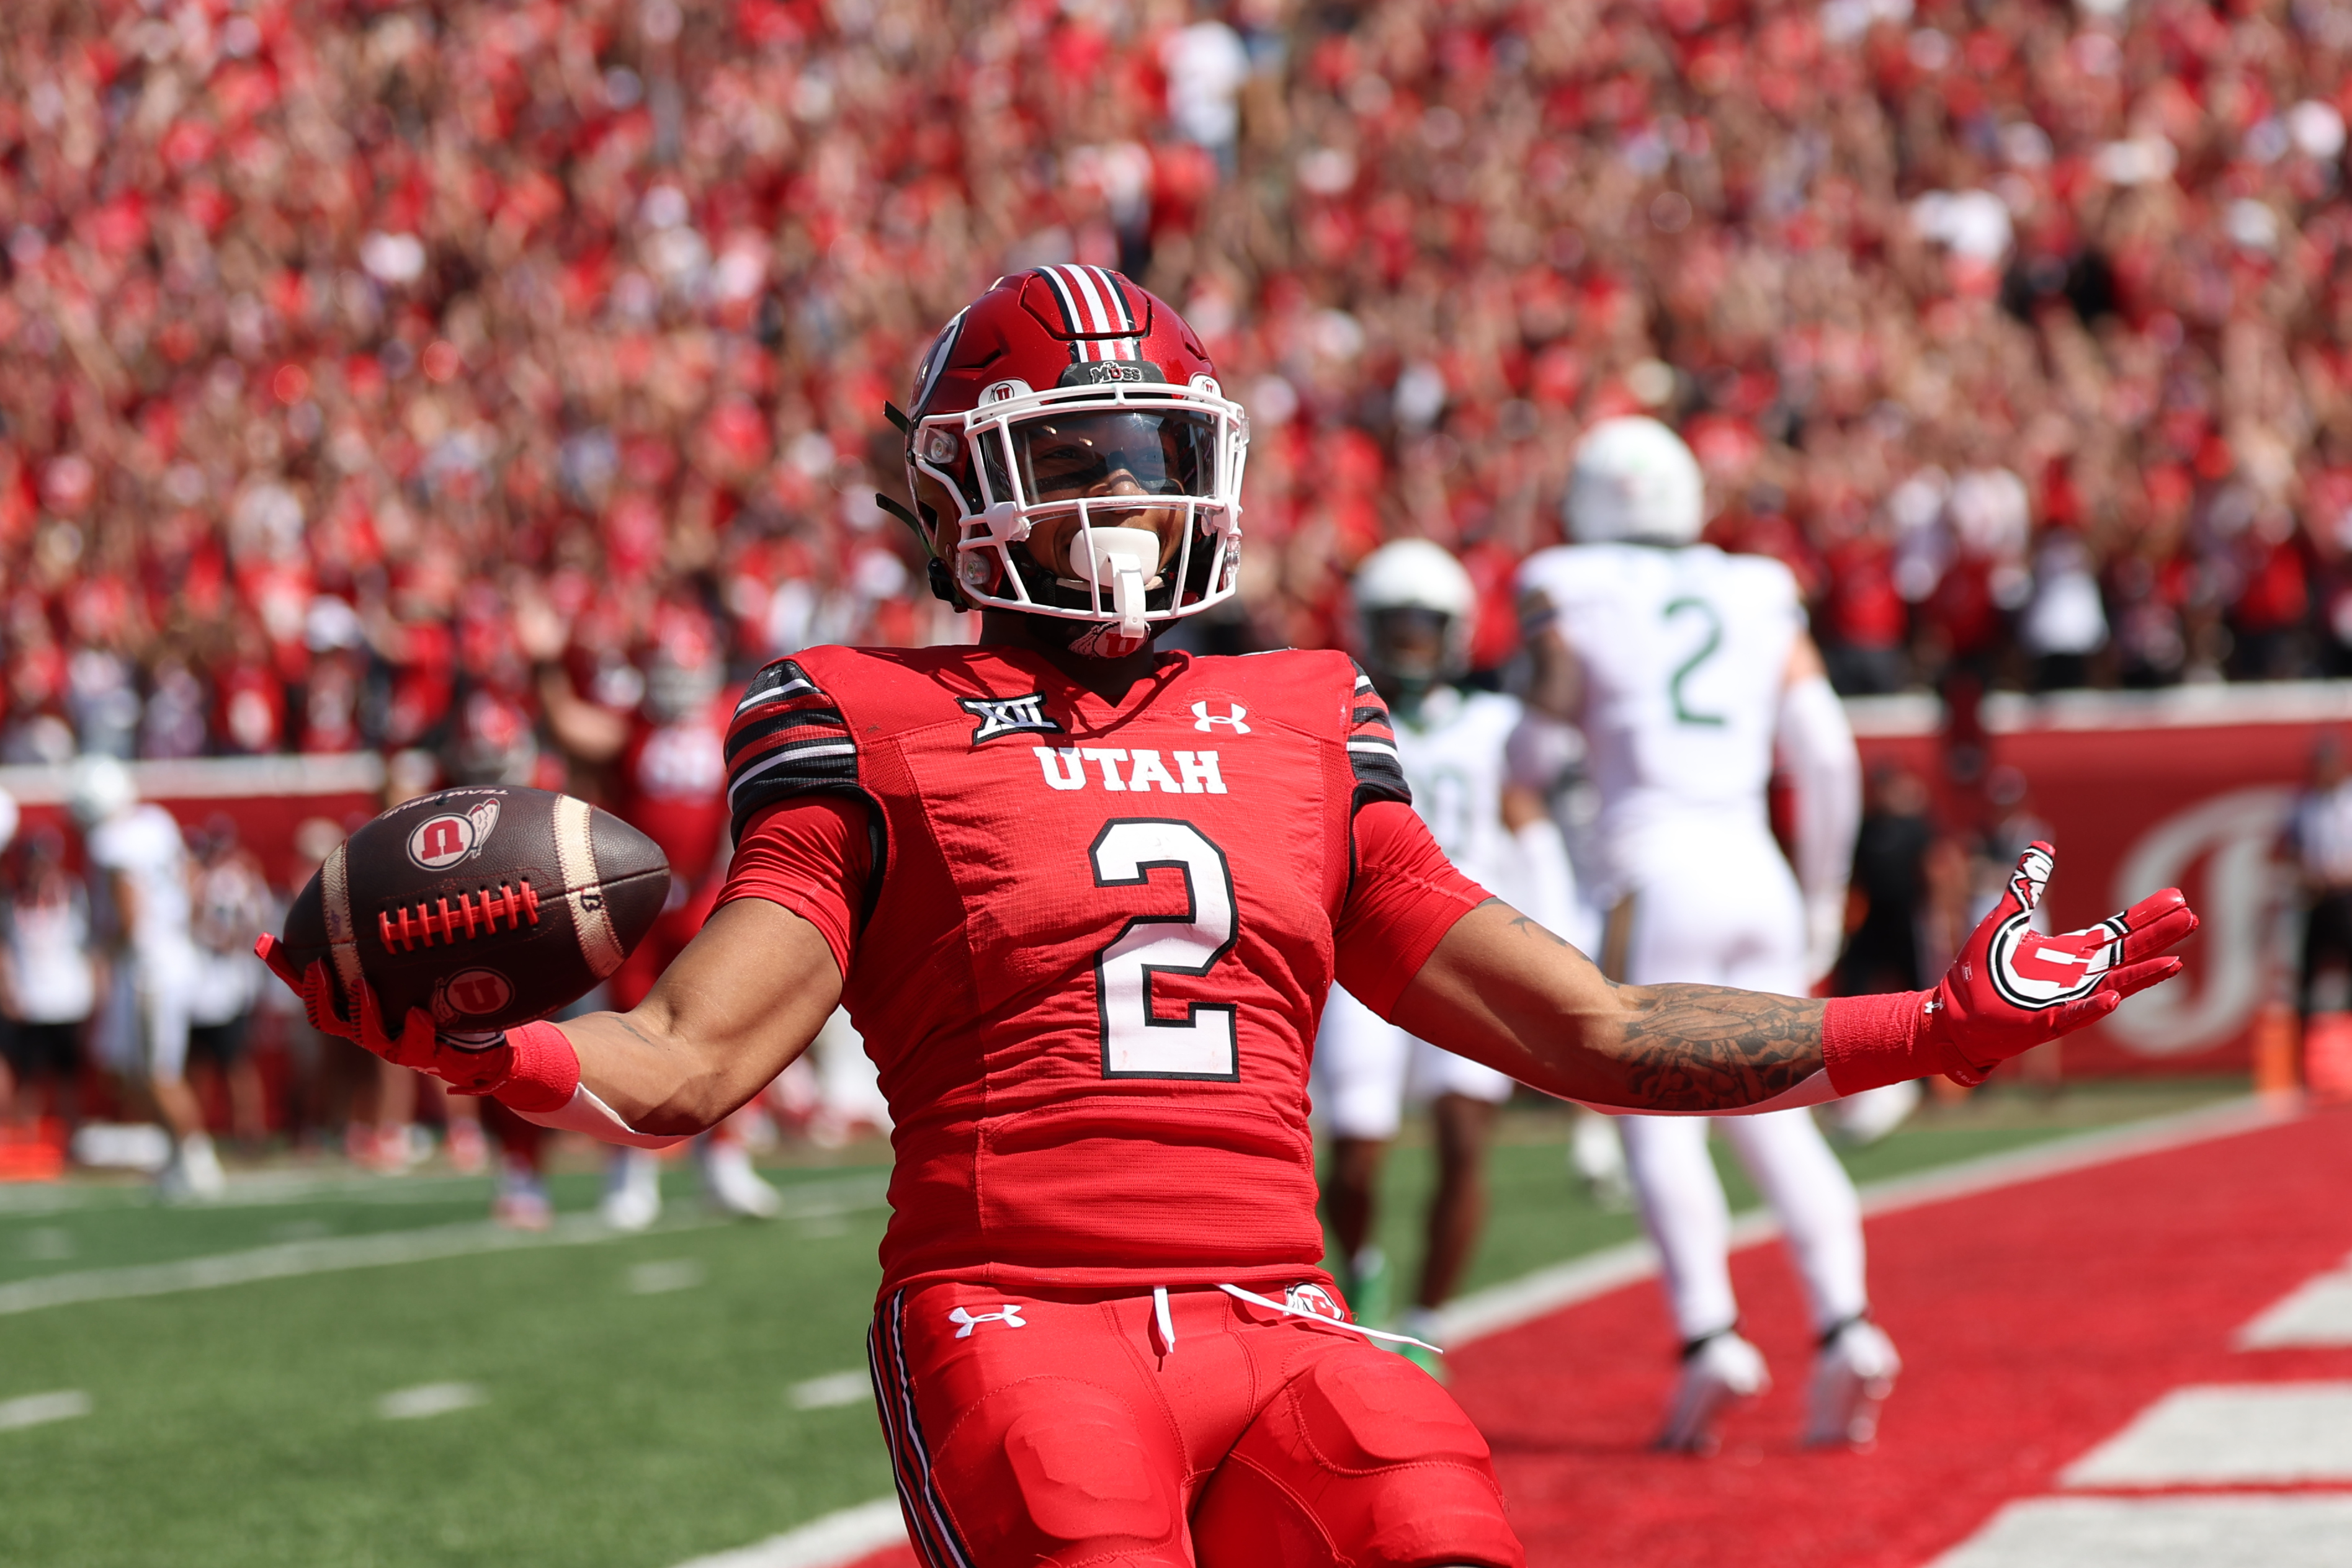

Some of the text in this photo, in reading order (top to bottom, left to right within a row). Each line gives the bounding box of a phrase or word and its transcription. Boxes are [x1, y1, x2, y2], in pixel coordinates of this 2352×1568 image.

[1663, 596, 1727, 724] 2
[964, 693, 1058, 739] XII
[1033, 747, 1228, 794] UTAH
[382, 789, 509, 820] TEAM ISSUE
[421, 819, 464, 861] U
[1089, 817, 1240, 1082] 2
[2010, 929, 2105, 988] U
[452, 976, 501, 1012] U
